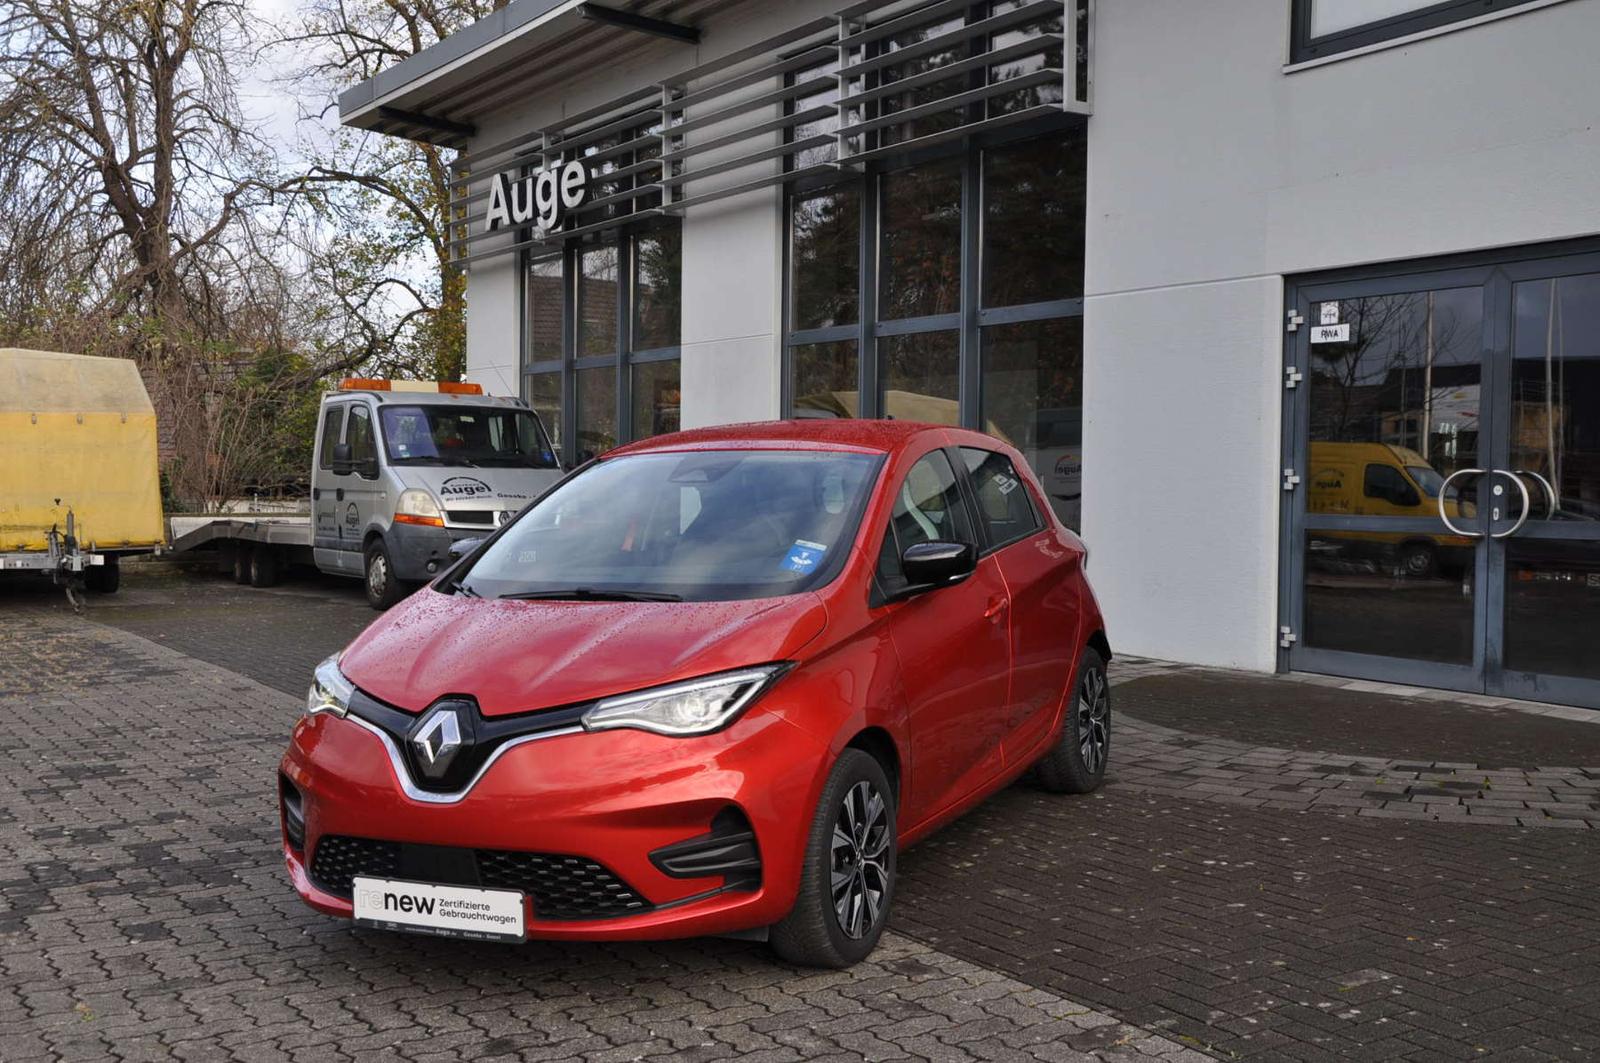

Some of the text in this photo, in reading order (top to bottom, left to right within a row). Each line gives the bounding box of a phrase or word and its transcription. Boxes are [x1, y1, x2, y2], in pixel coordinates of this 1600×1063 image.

[485, 160, 586, 231] Auge
[1320, 329, 1339, 338] RWA
[440, 485, 486, 496] Auge
[359, 888, 436, 916] renew
[439, 898, 491, 912] Zertifizierte
[439, 908, 517, 925] Gebrauchtwagen
